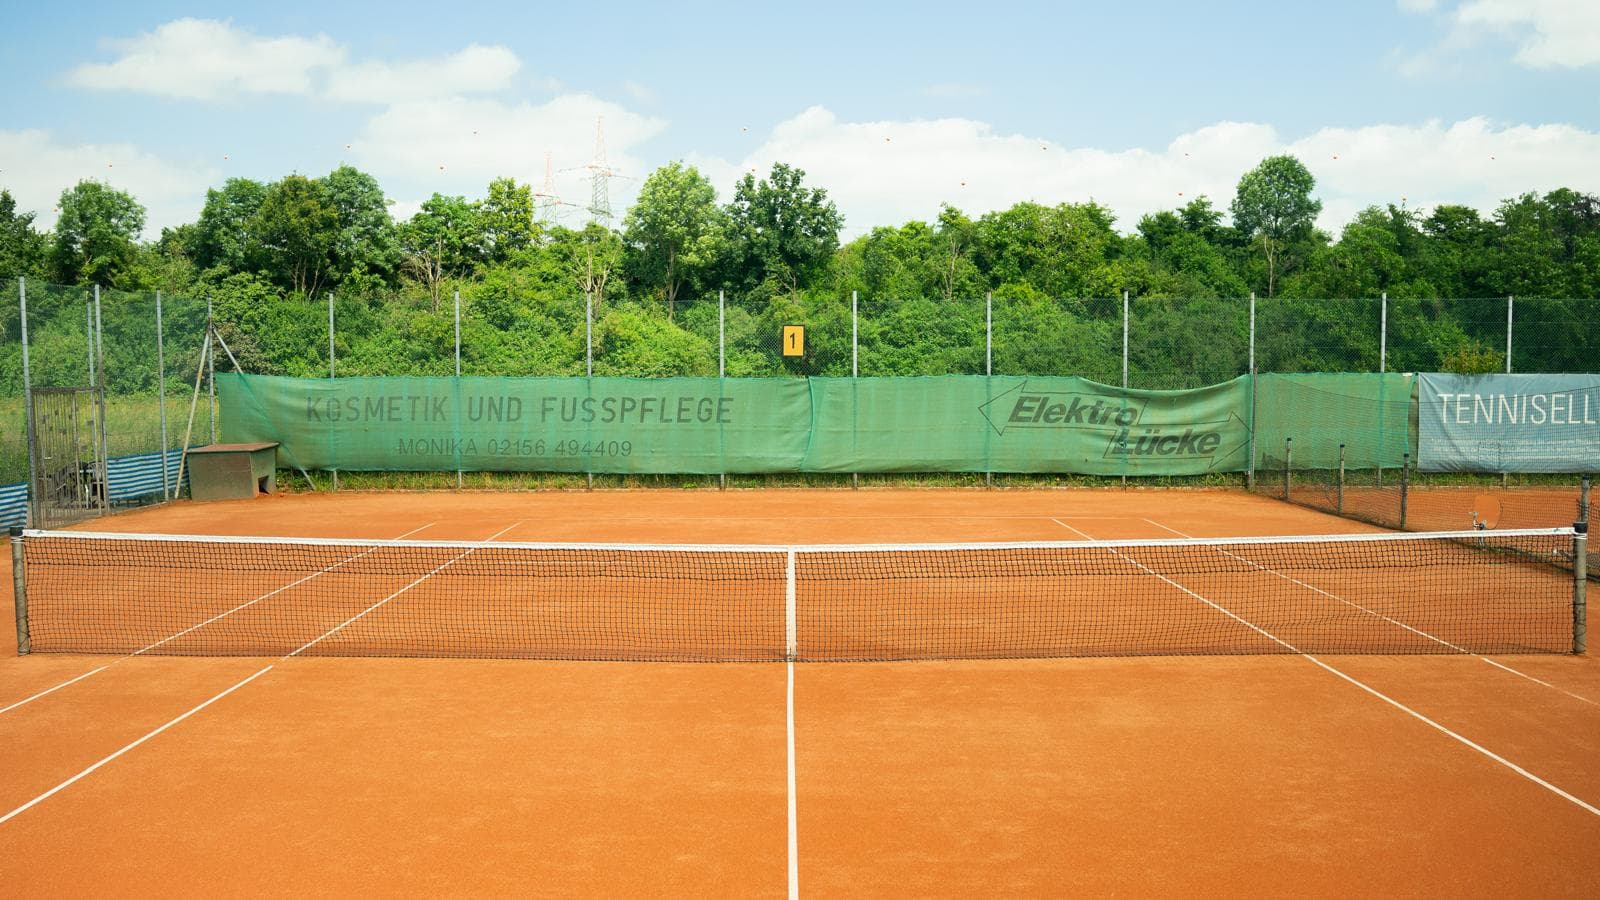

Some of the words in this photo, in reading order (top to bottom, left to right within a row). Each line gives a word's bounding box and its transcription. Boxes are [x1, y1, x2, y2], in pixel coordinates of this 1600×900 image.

[789, 332, 796, 349] 1
[306, 396, 449, 422] KOSMETIK
[468, 396, 522, 422] UND
[541, 397, 734, 424] FUSSPFLEGE
[1008, 396, 1138, 427] Elektro
[1437, 393, 1600, 425] TENNISELL
[399, 438, 479, 456] MONIKA
[555, 439, 633, 457] 494409
[1112, 429, 1221, 456] Lücke
